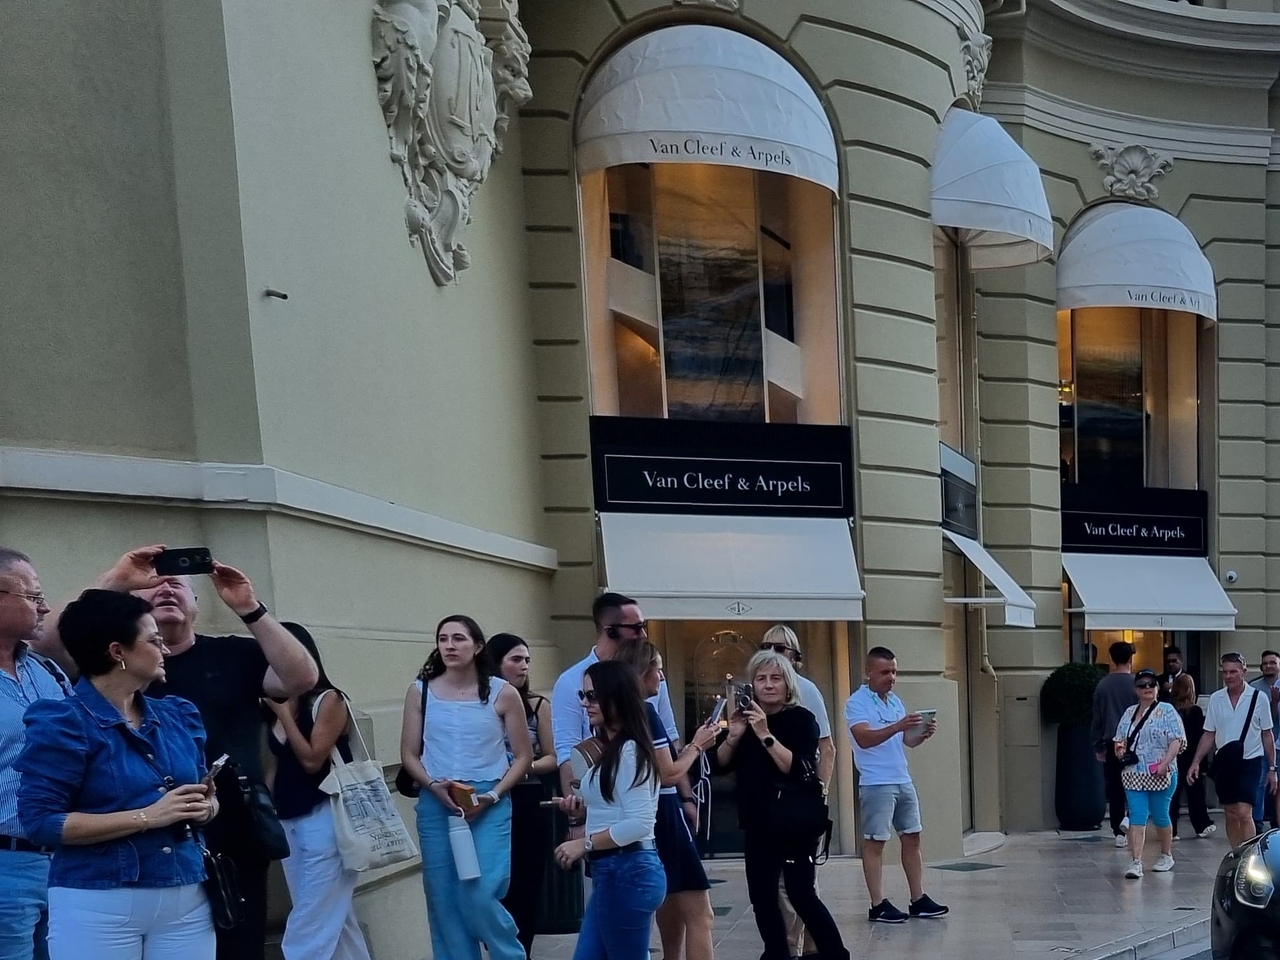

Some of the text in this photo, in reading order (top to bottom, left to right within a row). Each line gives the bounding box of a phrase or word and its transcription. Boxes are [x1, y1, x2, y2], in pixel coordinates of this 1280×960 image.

[649, 138, 791, 166] Van Cleef & Arpels
[1127, 289, 1148, 302] Van
[1150, 290, 1177, 304] Cleef
[1179, 296, 1187, 305] &
[642, 470, 811, 496] Van Cleef & Arpels
[1084, 522, 1185, 542] Van Cleef & Arpels
